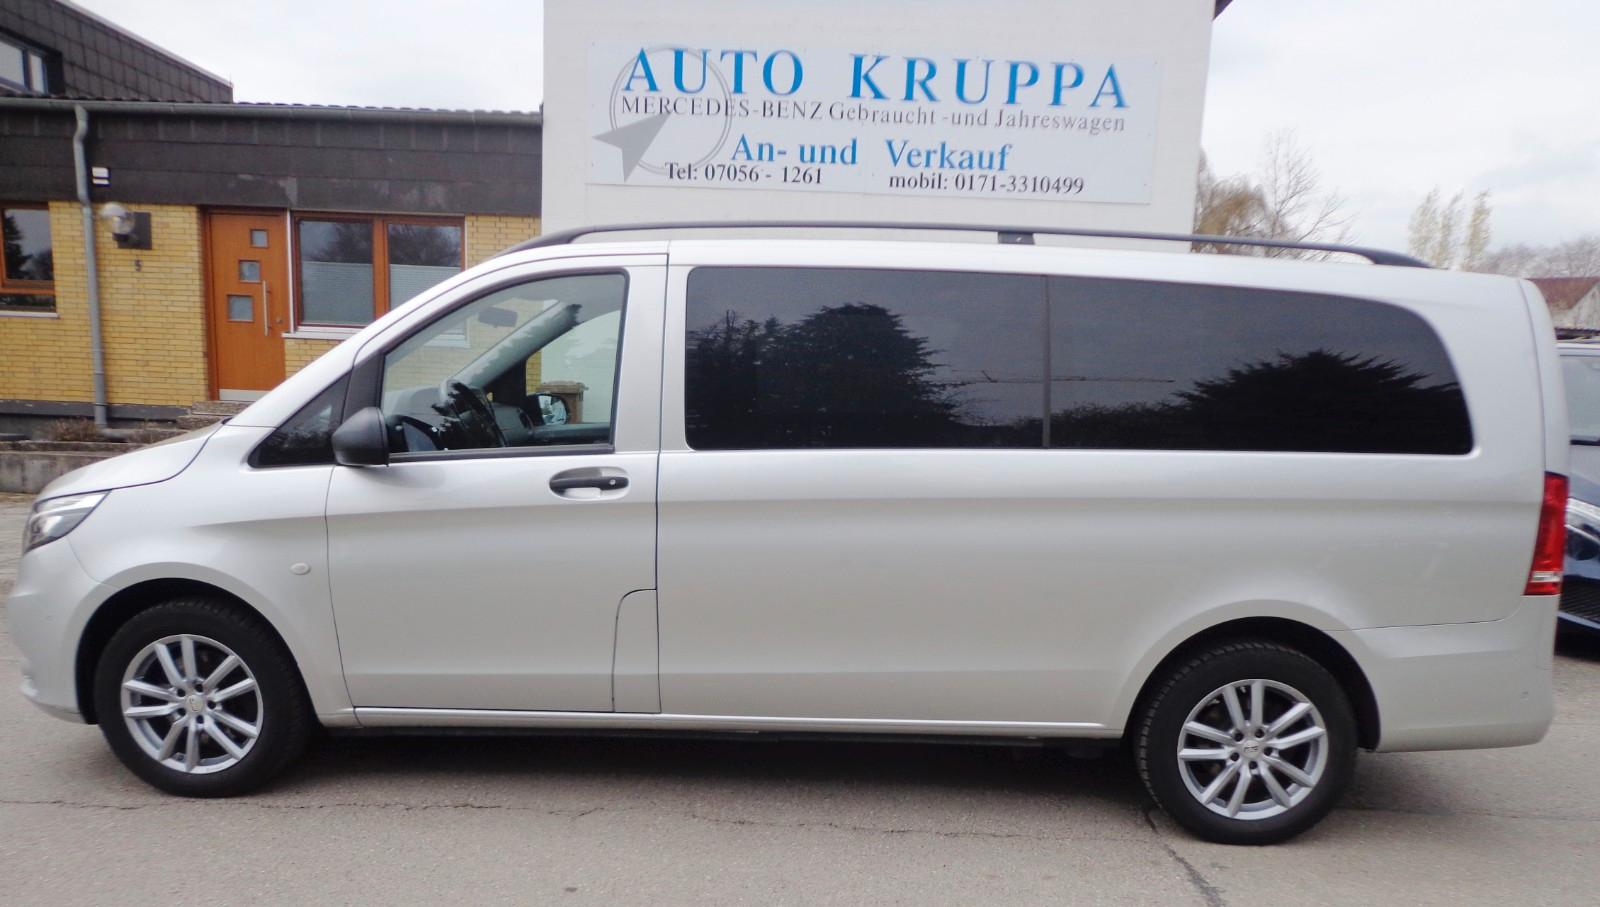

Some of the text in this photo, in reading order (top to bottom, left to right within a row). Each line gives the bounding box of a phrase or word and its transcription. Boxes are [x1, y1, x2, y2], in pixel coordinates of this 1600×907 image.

[622, 48, 1129, 108] AUTO KRUPPA
[621, 96, 822, 119] MERCEDES-BENZ
[829, 101, 935, 124] Gebraucht
[994, 110, 1125, 136] Jahreswagen
[731, 134, 1013, 171] An- und Verkauf
[664, 163, 698, 180] Tel:
[704, 164, 759, 182] 07056
[782, 167, 822, 184] 1261
[889, 173, 1084, 194] mobil: 0171-3310499
